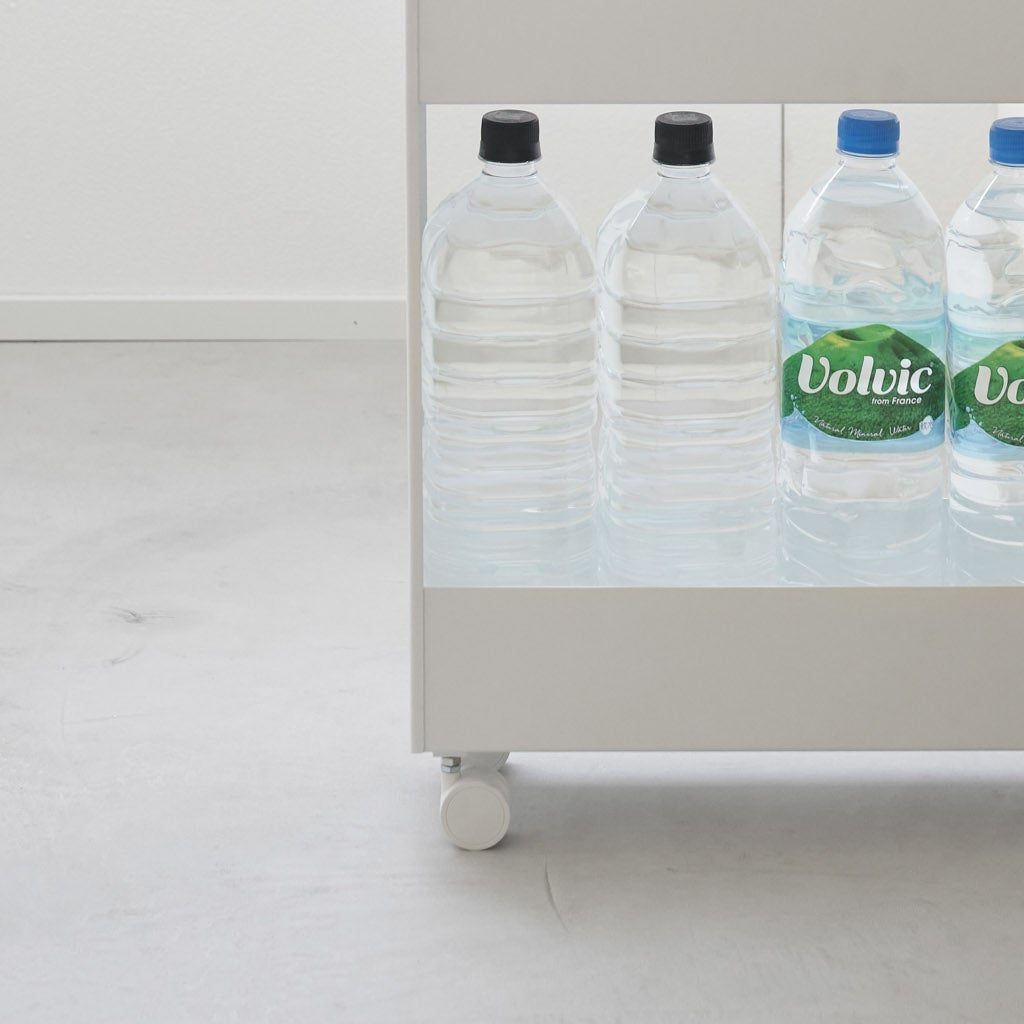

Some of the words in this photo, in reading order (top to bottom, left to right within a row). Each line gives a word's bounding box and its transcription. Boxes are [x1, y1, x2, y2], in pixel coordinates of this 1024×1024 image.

[798, 354, 933, 395] Volvic
[872, 397, 890, 405] from
[891, 396, 922, 405] France
